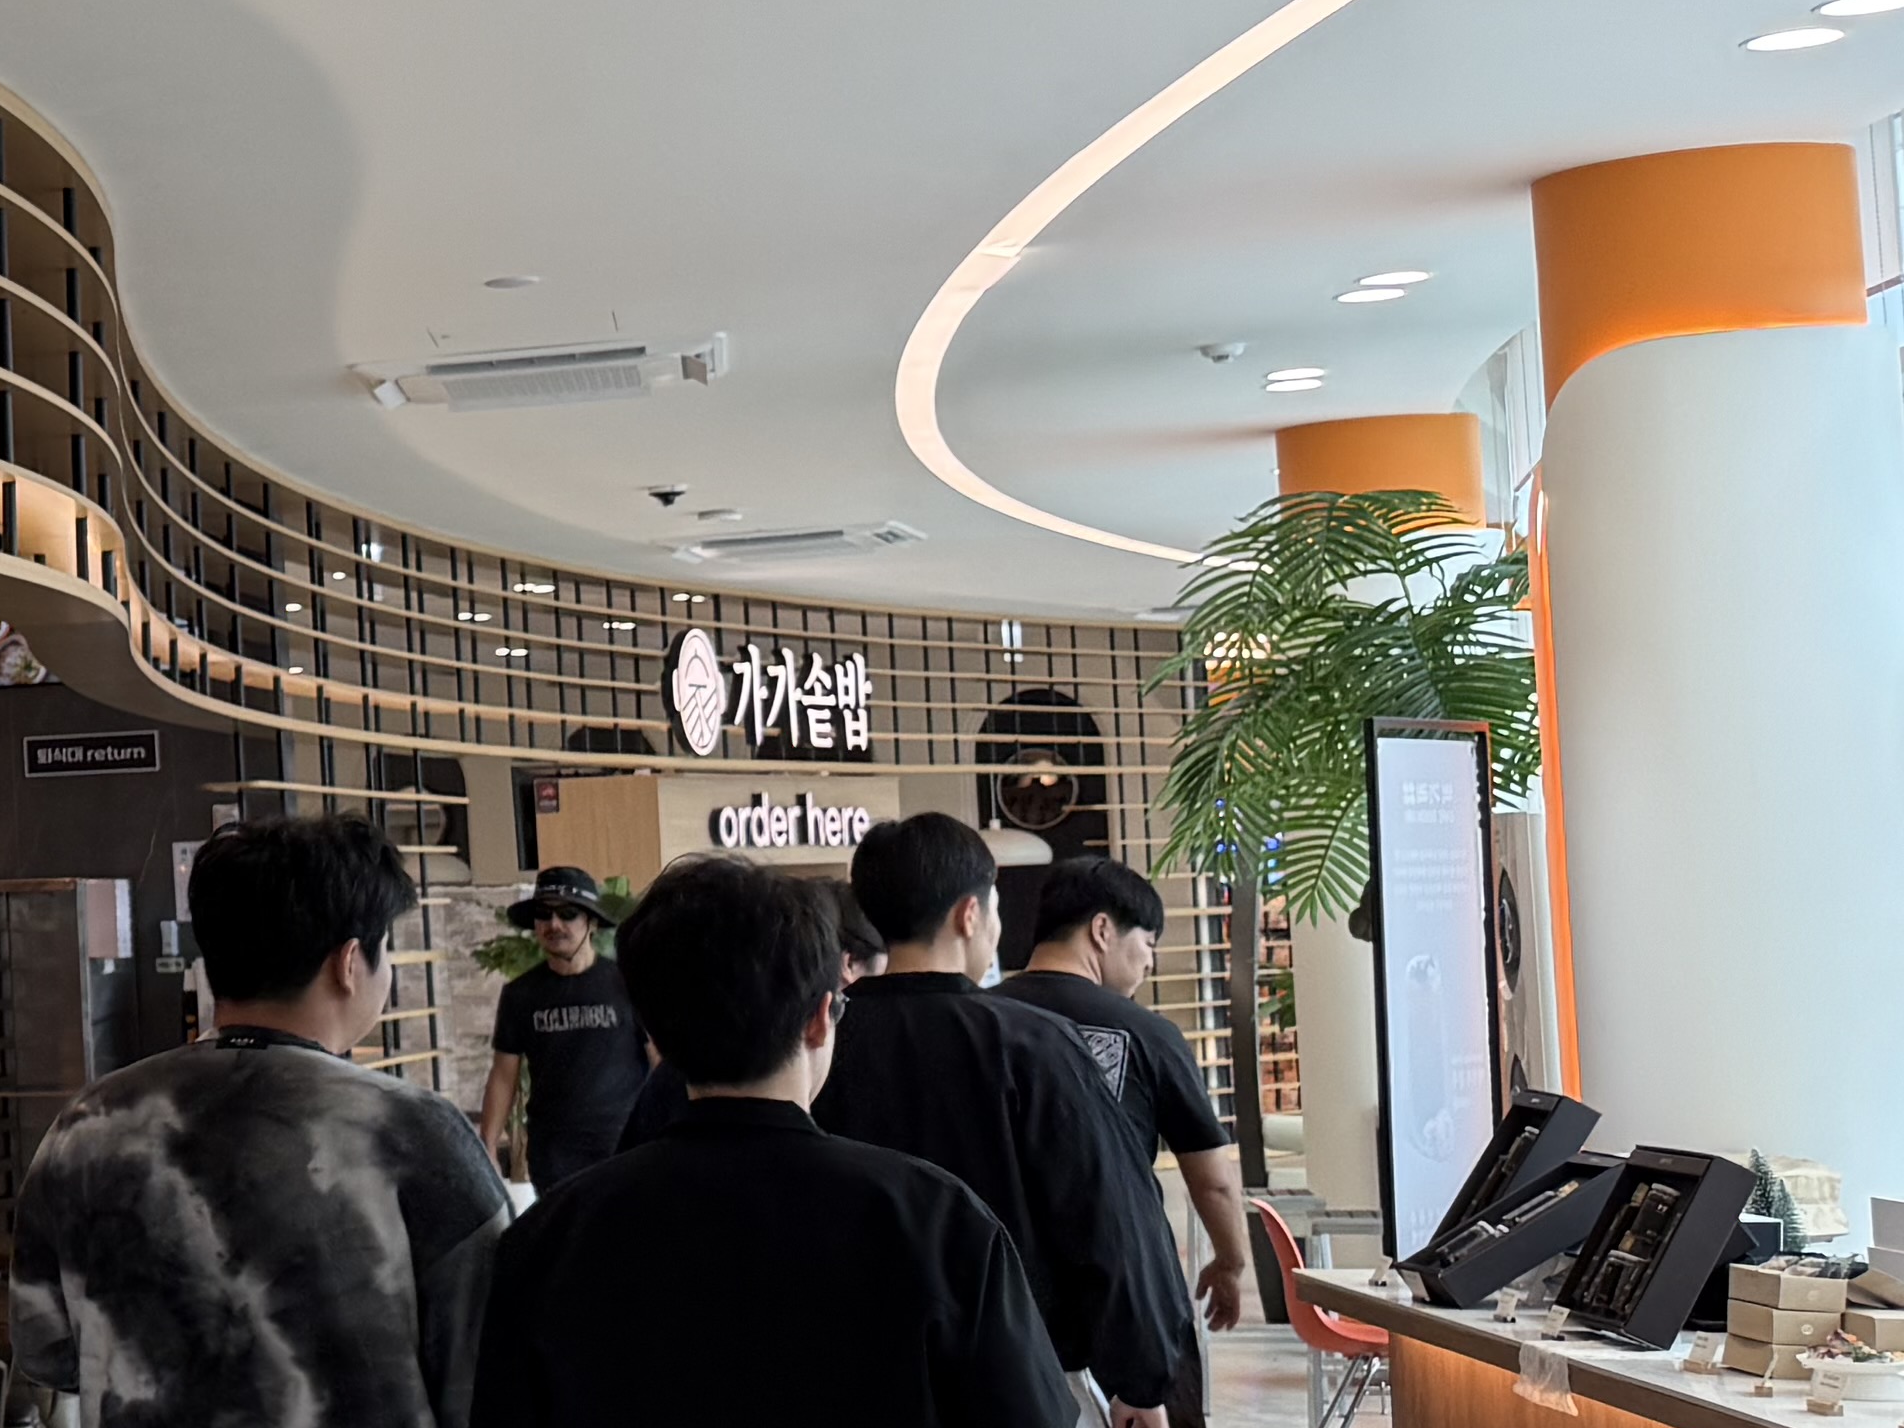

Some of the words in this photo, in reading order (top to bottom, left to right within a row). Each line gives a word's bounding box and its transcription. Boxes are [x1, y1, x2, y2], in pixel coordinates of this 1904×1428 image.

[733, 643, 873, 752] 가가솥밥
[87, 745, 147, 763] return
[718, 793, 799, 848] order
[806, 792, 872, 848] here
